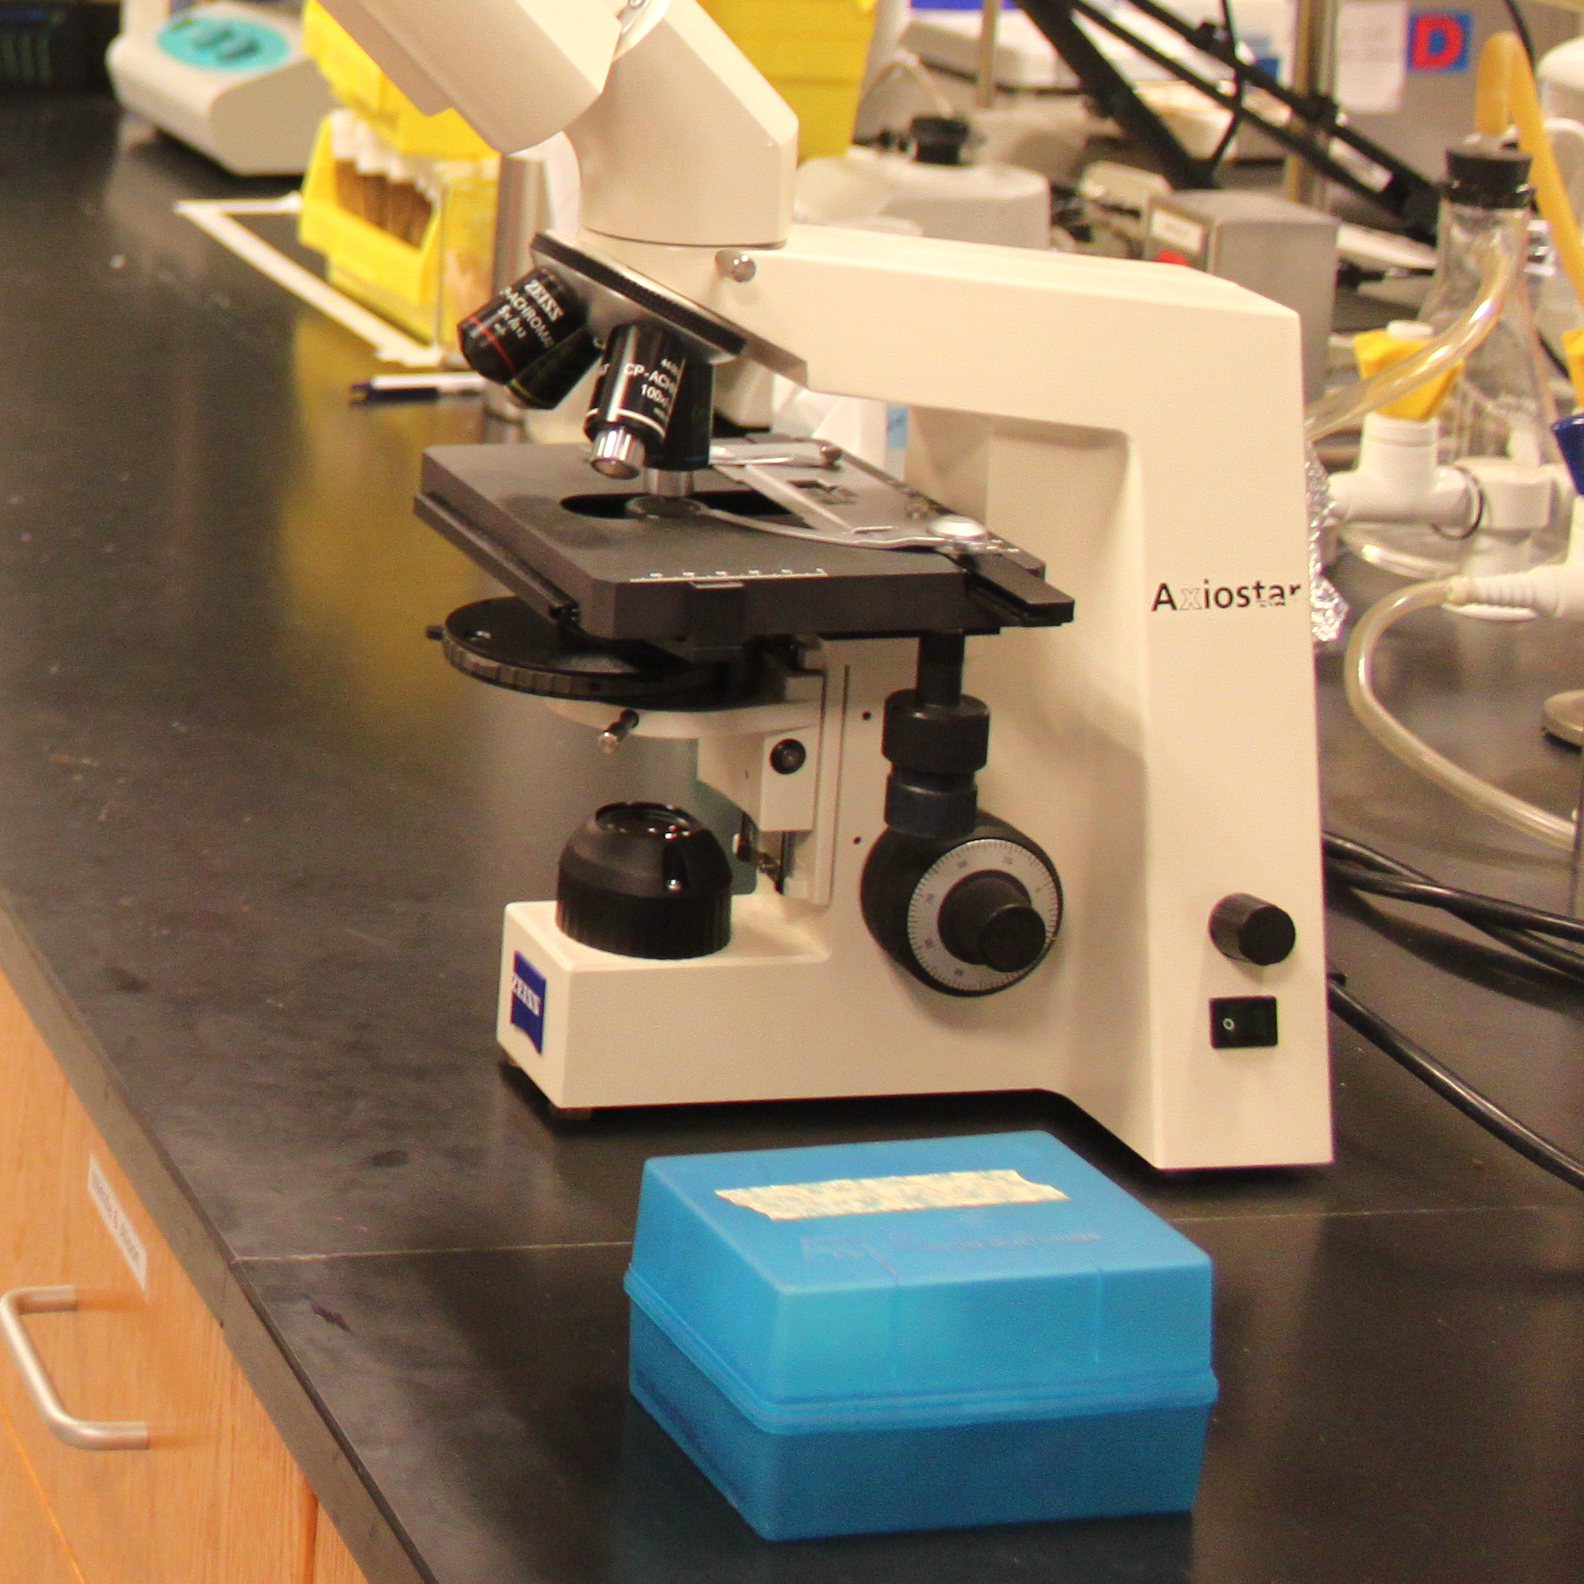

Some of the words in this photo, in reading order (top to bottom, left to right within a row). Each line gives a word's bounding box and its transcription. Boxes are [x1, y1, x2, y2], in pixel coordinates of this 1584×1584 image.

[1412, 11, 1466, 72] D
[524, 279, 564, 322] ZEISS
[1150, 578, 1302, 612] Axiostar
[512, 973, 541, 1016] ZEISS
